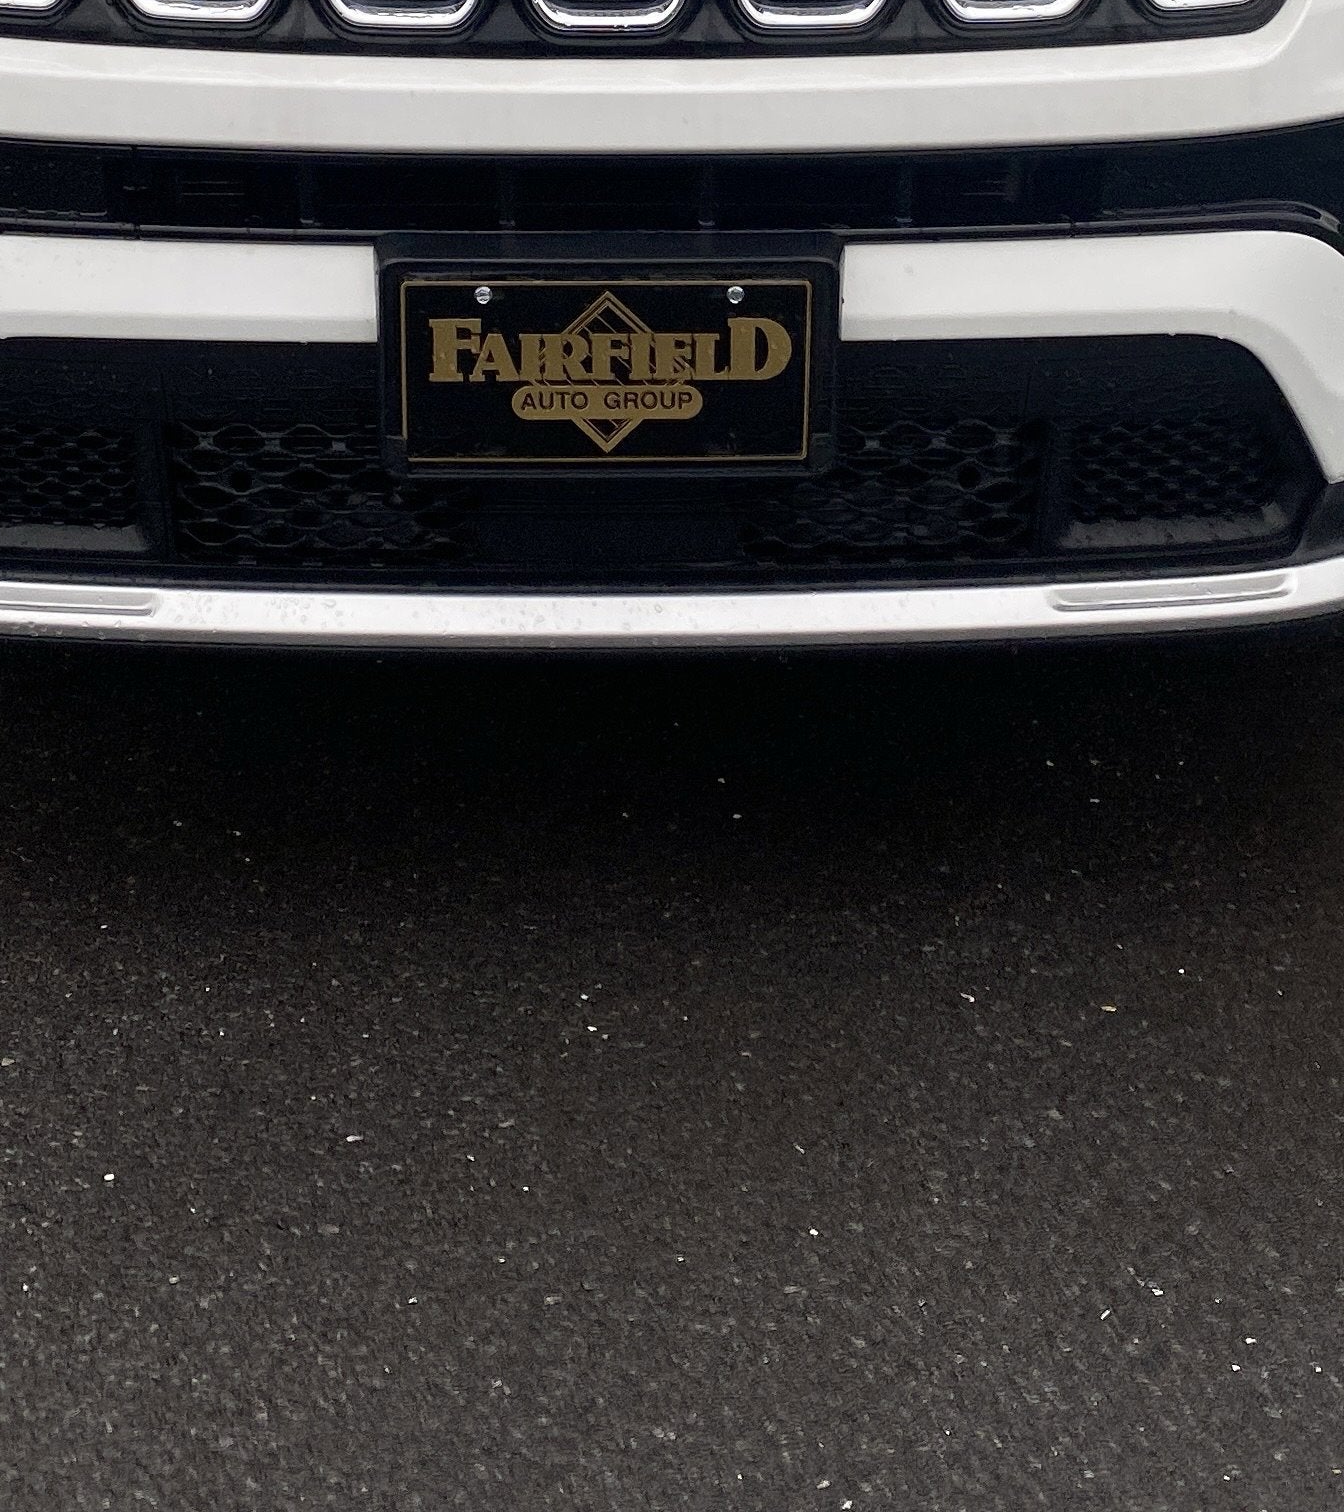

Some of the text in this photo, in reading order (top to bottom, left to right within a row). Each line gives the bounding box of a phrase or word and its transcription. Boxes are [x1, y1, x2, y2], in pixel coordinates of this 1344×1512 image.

[428, 317, 793, 383] FAIRFIELD
[520, 391, 693, 410] AUTO GROUP
